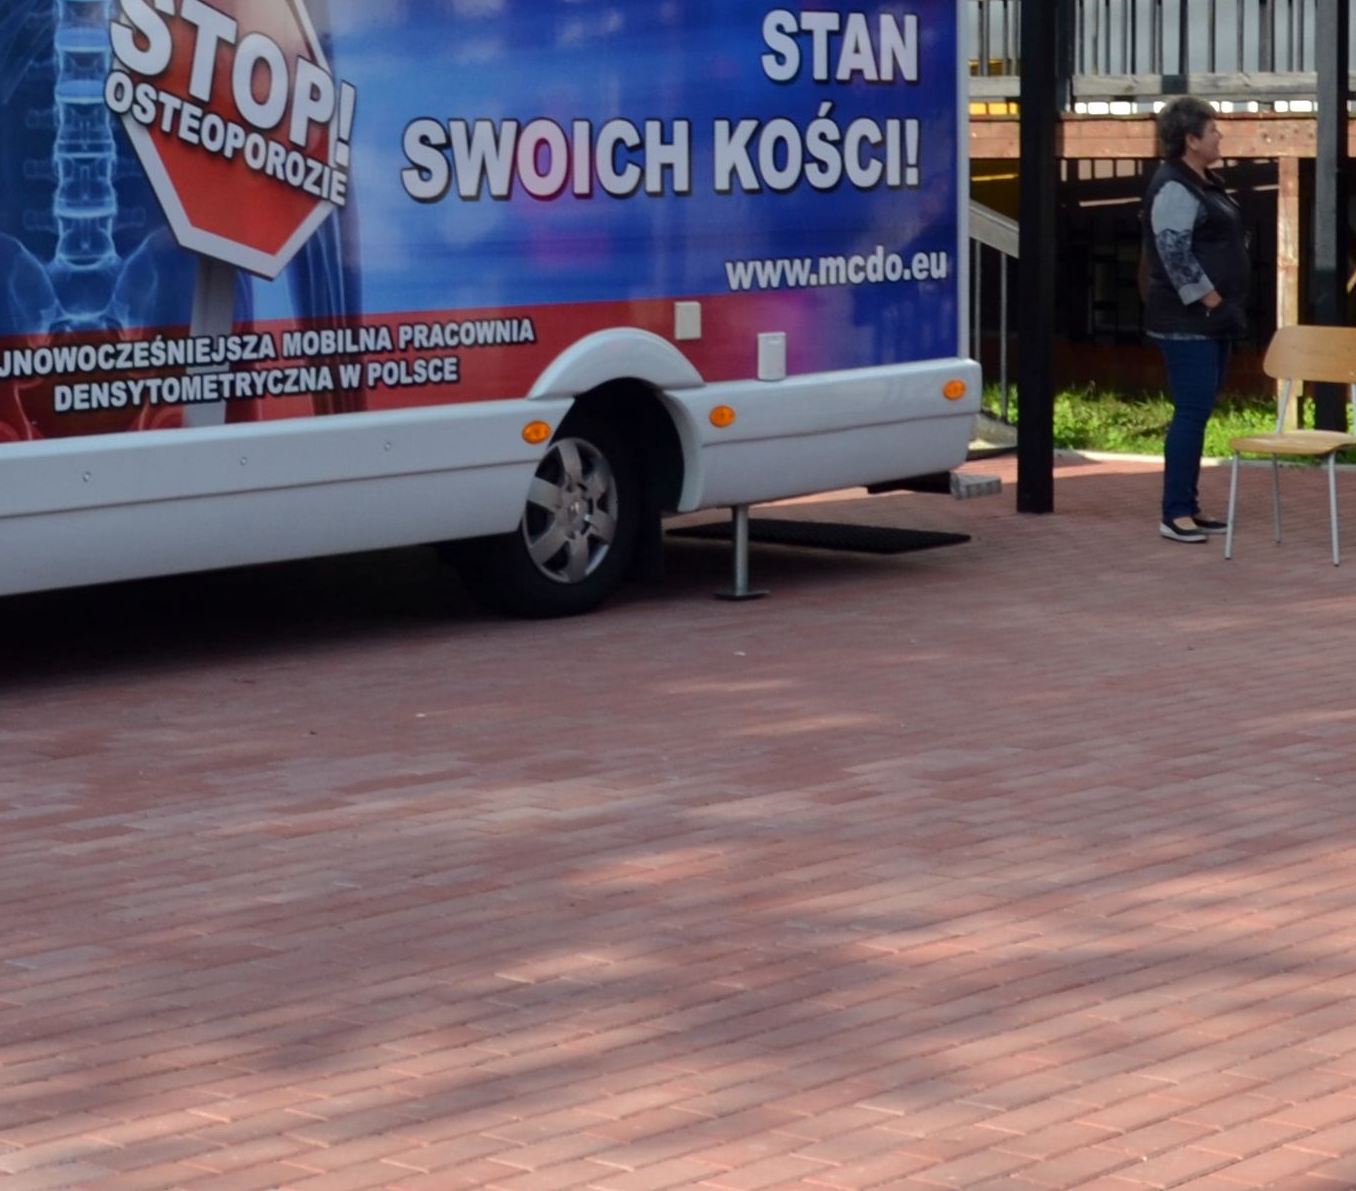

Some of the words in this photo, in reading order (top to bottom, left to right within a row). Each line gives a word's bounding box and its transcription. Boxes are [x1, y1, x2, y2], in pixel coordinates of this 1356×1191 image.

[761, 9, 921, 84] STAN
[104, 69, 348, 208] OSTEOPOROZIE
[401, 116, 690, 200] SWOICH
[711, 100, 921, 194] KOŚCI!
[725, 246, 948, 291] www.mcdo.eu
[281, 323, 392, 359] MOBILNA
[397, 318, 536, 353] PRACOWNIA
[54, 363, 333, 412] DENSYTOMETRYCZNA
[338, 361, 365, 389] W
[370, 355, 459, 388] POLSCE
